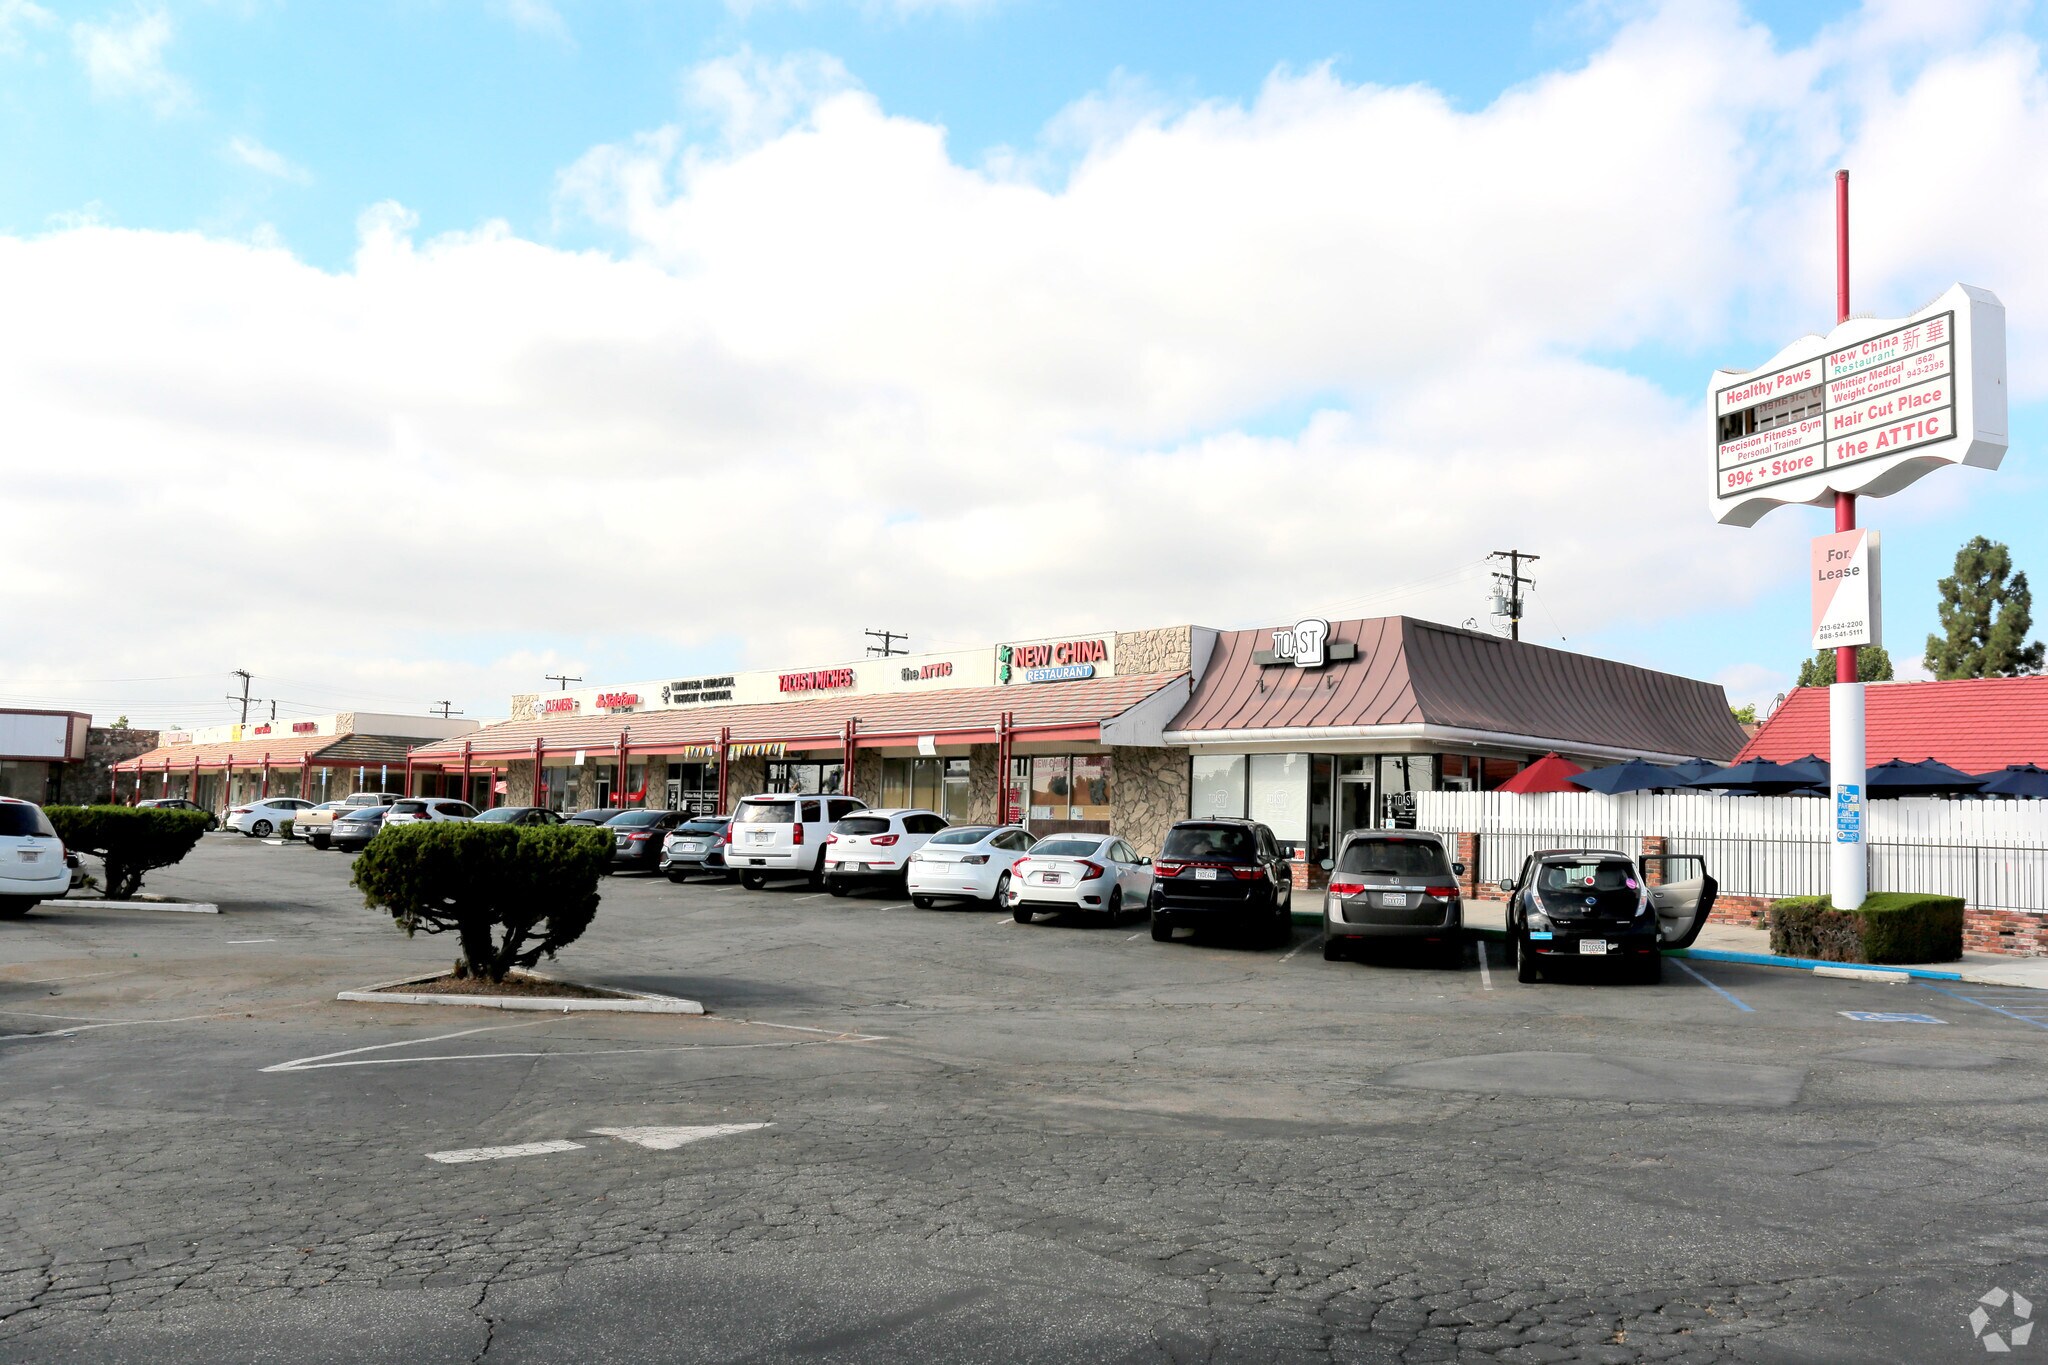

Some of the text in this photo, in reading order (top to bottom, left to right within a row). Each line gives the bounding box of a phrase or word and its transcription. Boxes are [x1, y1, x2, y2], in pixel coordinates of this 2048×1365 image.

[1830, 336, 1899, 366] New China
[1834, 348, 1895, 375] Restaurant
[1915, 353, 1935, 366] (562)
[1831, 361, 1904, 393] Whittier Medical
[1907, 360, 1944, 379] 943-2395
[1726, 369, 1811, 405] Healthy Paws
[1834, 374, 1901, 404] Weight Control
[1834, 411, 1863, 430] Hair
[1868, 401, 1893, 420] Cut
[1898, 390, 1942, 411] Place
[1721, 420, 1821, 455] Precision Fitness Gym
[1837, 417, 1939, 460] the ATTIC
[1737, 437, 1802, 460] Personal Trainer
[1772, 455, 1813, 476] Store
[1828, 549, 1850, 561] For
[1818, 566, 1860, 581] Lease
[1820, 620, 1863, 632] 213-624-2200
[1820, 629, 1863, 640] 888-541-5111
[1015, 640, 1107, 667] NEW CHINA
[1274, 630, 1318, 656] TOAST
[779, 672, 807, 692] TACOS
[901, 662, 952, 681] the ATTIC
[1027, 665, 1090, 681] RESTAURANT
[546, 698, 574, 712] CLEANERS
[1394, 795, 1414, 806] TOAST
